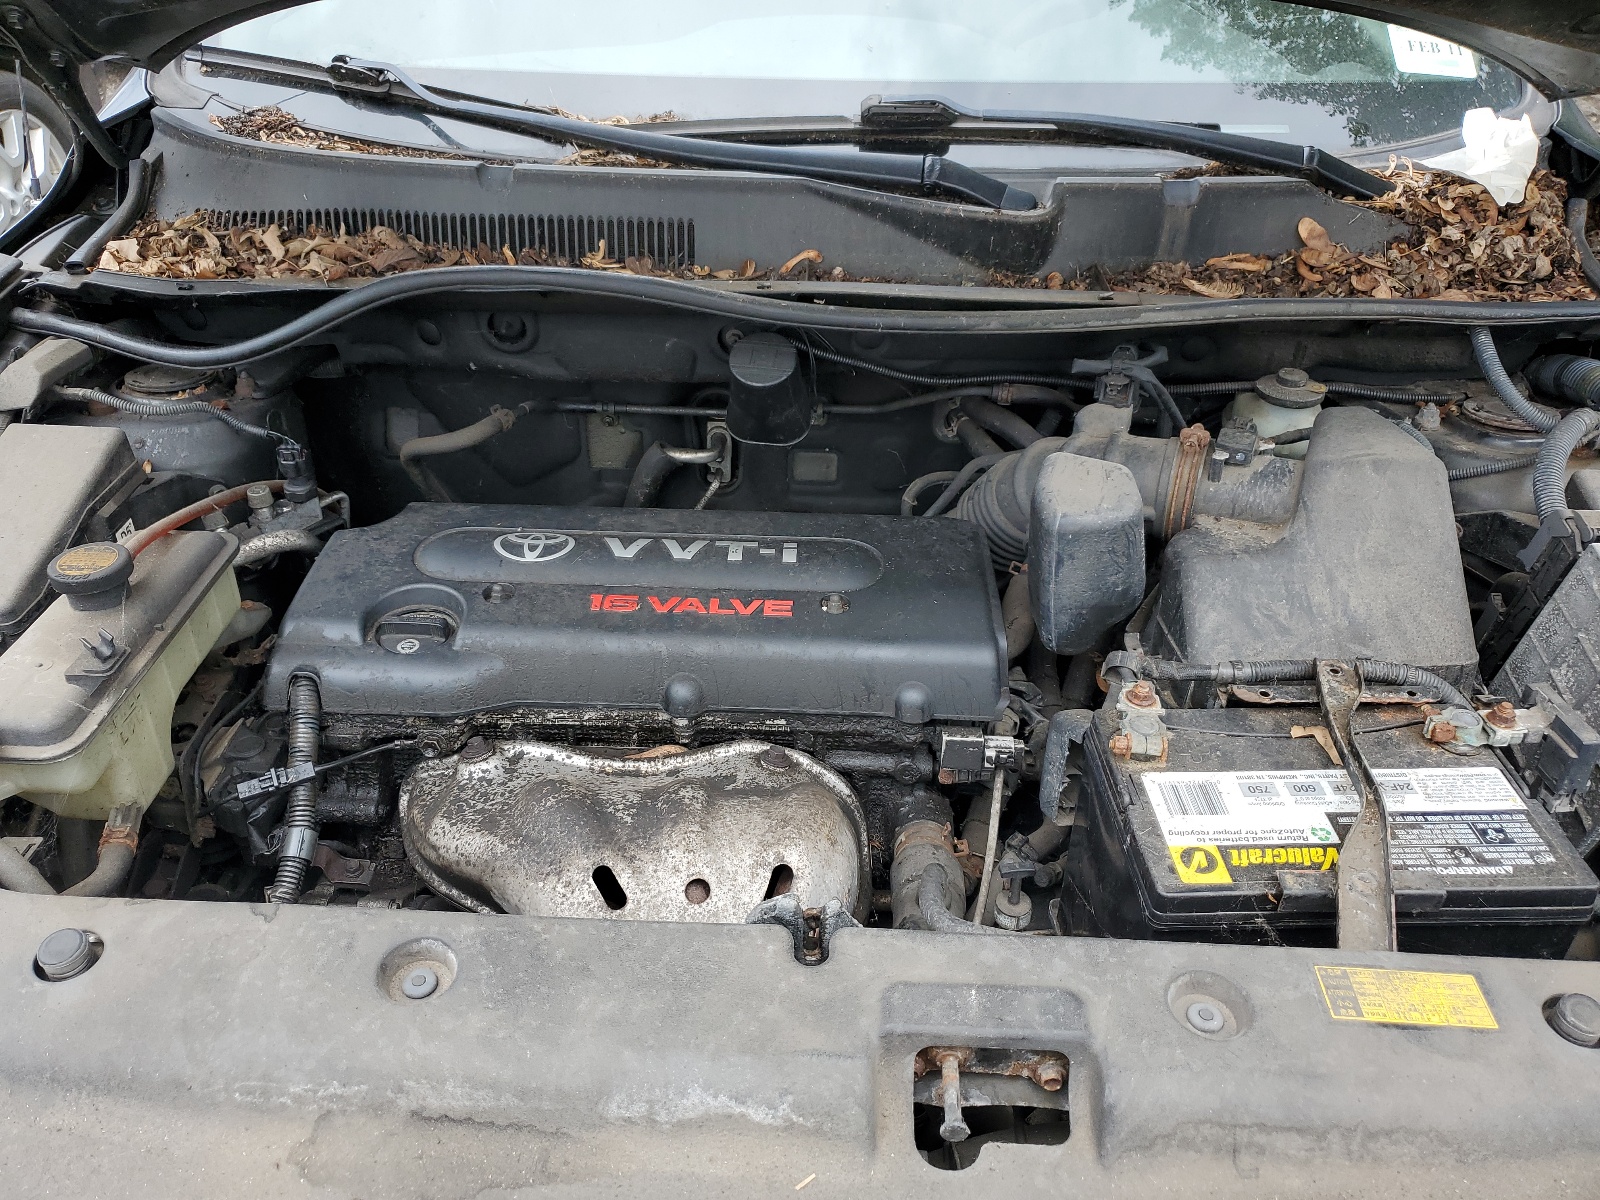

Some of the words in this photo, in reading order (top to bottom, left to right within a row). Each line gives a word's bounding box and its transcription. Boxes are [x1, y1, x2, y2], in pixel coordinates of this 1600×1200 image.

[1408, 40, 1441, 53] FEB
[1449, 44, 1462, 56] 11
[590, 593, 640, 612] 16
[648, 596, 794, 616] VALVE
[1248, 785, 1271, 793] 750
[1293, 784, 1316, 792] 600
[1230, 848, 1338, 870] Valucraft
